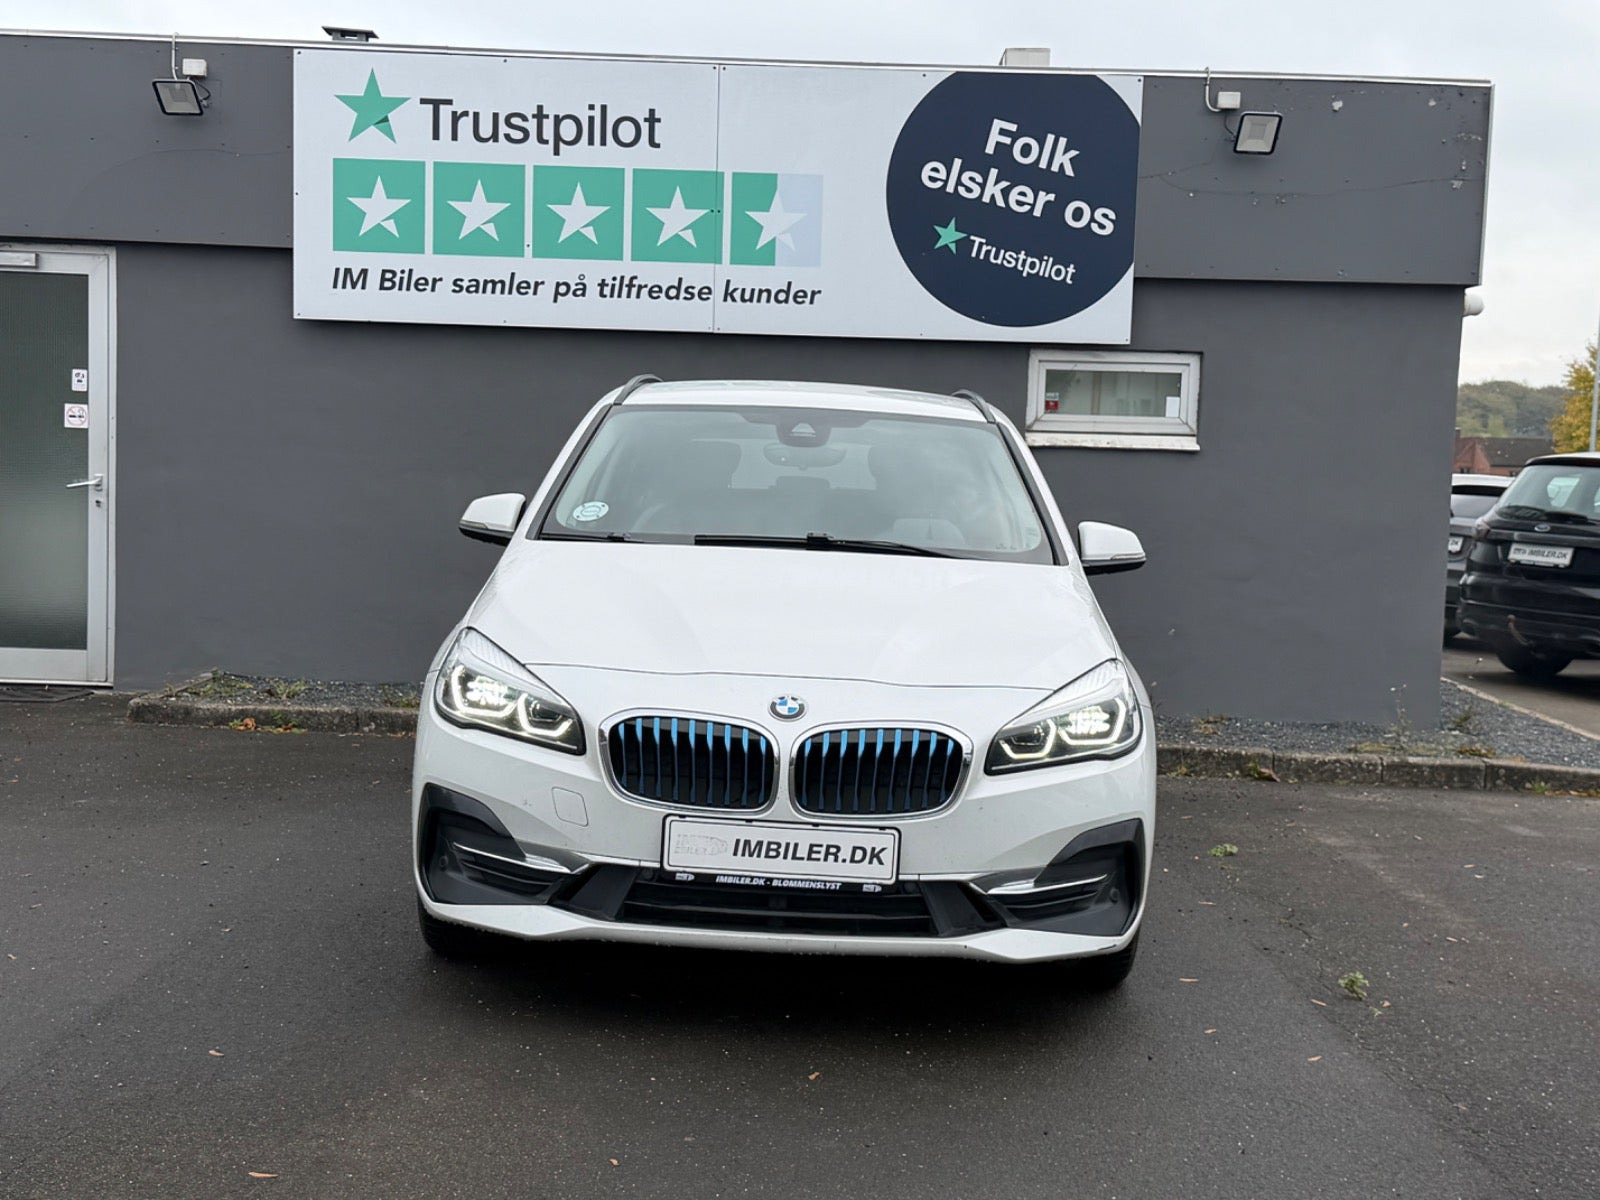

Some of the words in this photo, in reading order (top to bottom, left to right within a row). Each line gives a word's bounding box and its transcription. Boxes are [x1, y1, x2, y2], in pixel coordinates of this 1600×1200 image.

[419, 97, 662, 157] Trustpilot
[984, 118, 1080, 177] Folk
[920, 157, 1055, 218] elsker
[1063, 200, 1116, 236] os
[969, 235, 1076, 285] Trustpilot
[332, 267, 369, 290] IM
[378, 268, 443, 293] Biler
[451, 272, 545, 296] samler
[552, 274, 588, 303] på
[597, 275, 713, 301] tilfredse
[722, 279, 822, 305] kunder
[732, 838, 888, 866] IMBILER.DK
[715, 875, 766, 886] IMBILER.DK
[771, 879, 842, 890] BLOMMENSLYST
